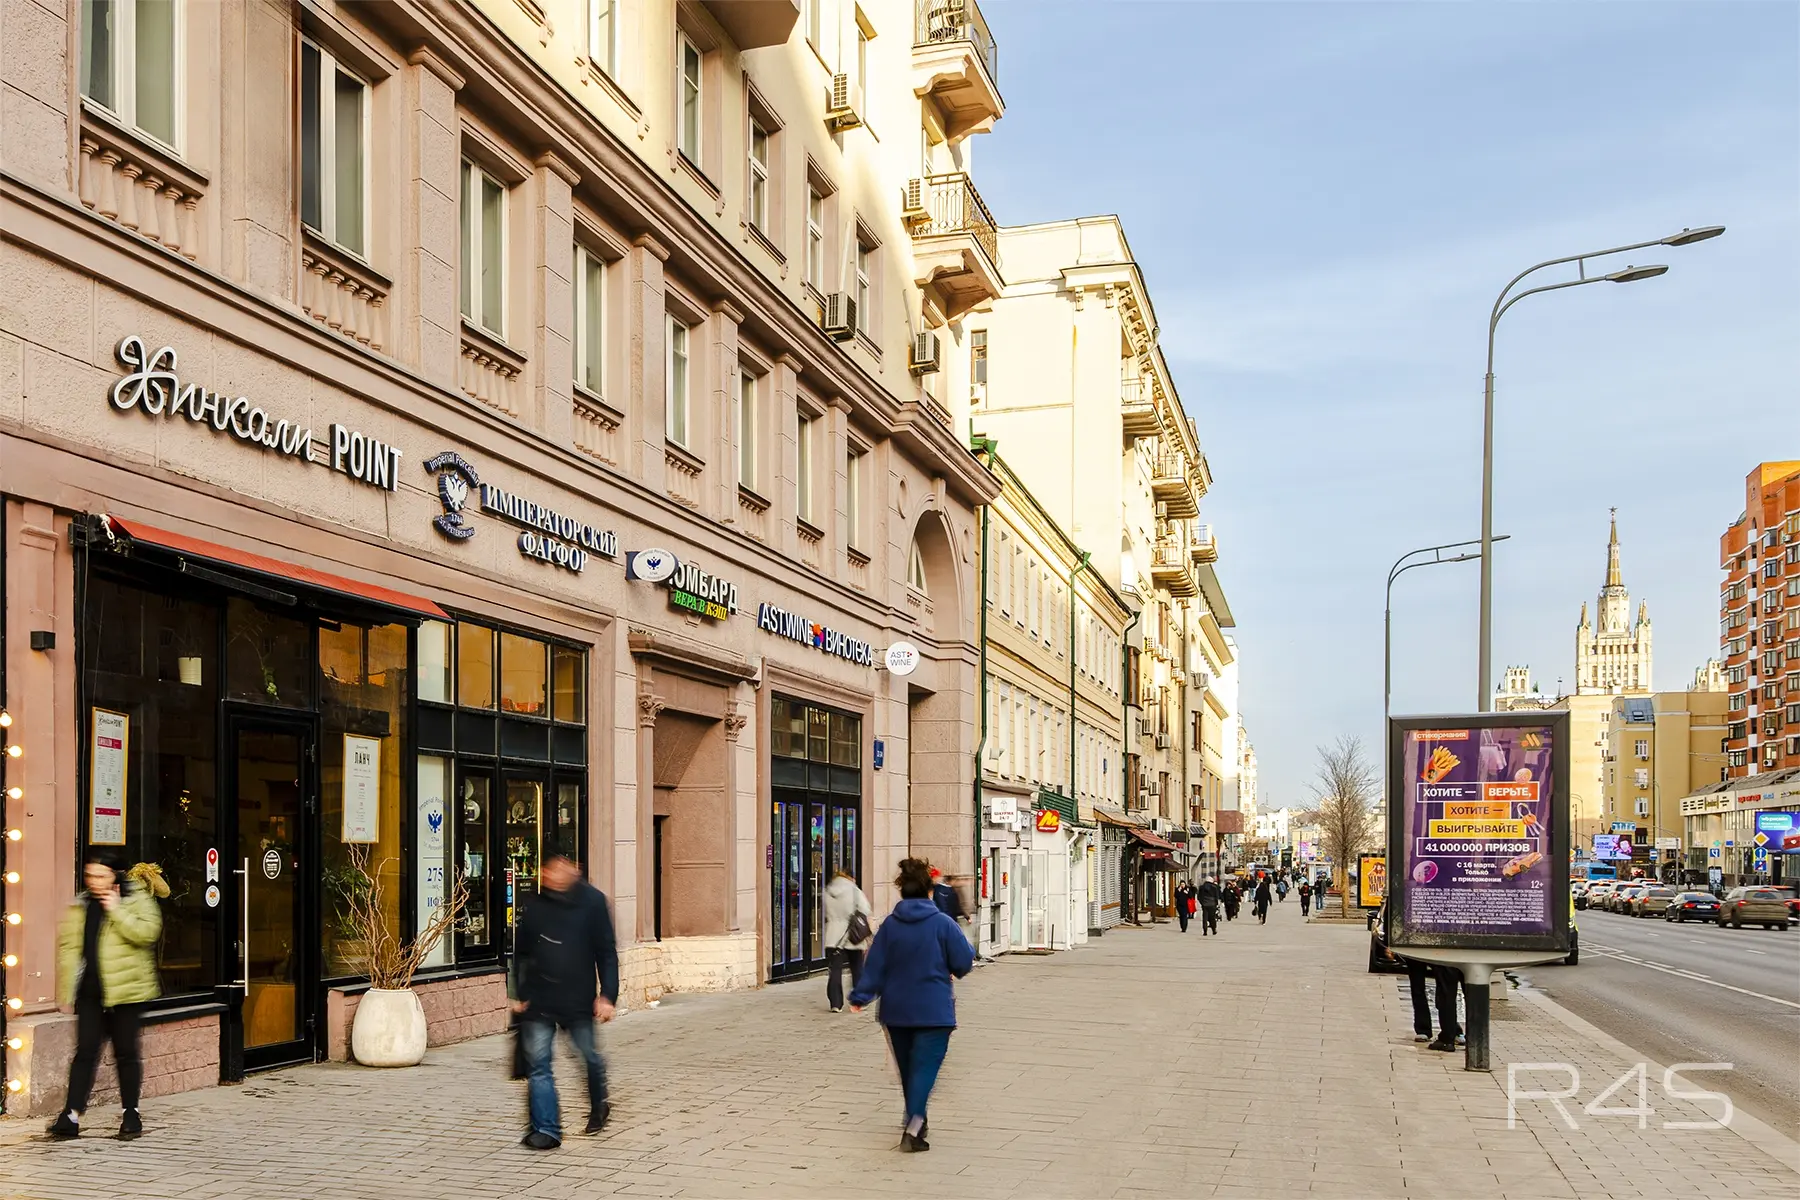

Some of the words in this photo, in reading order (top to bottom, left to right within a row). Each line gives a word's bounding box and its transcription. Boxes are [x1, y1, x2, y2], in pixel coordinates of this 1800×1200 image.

[330, 424, 403, 492] POINT
[429, 453, 455, 470] Imperial
[455, 454, 480, 486] Porcelain
[484, 484, 618, 558] ИМПЕРАТОРСКИЙ
[521, 532, 588, 572] ФАРФОР
[670, 562, 738, 614] ОМБАРД
[674, 590, 698, 612] ВЕРА
[699, 598, 706, 612] В
[706, 601, 728, 621] КЭШ
[761, 603, 815, 645] AST.WINE
[890, 651, 906, 659] AST
[1416, 731, 1467, 740] стикермания
[1423, 788, 1463, 797] ХОТИТЕ
[1488, 788, 1532, 797] ВЕРЬТЕ,
[1450, 806, 1489, 815] ХОТИТЕ
[1437, 823, 1518, 833] ВЫИГРЫВАЙТЕ
[1425, 843, 1439, 852] 41
[1440, 843, 1460, 852] 000
[1462, 843, 1483, 852] 000
[1485, 843, 1530, 852] ПРИЗОВ
[1473, 862, 1497, 870] марта.
[427, 867, 443, 882] 275
[1530, 880, 1543, 888] 12+
